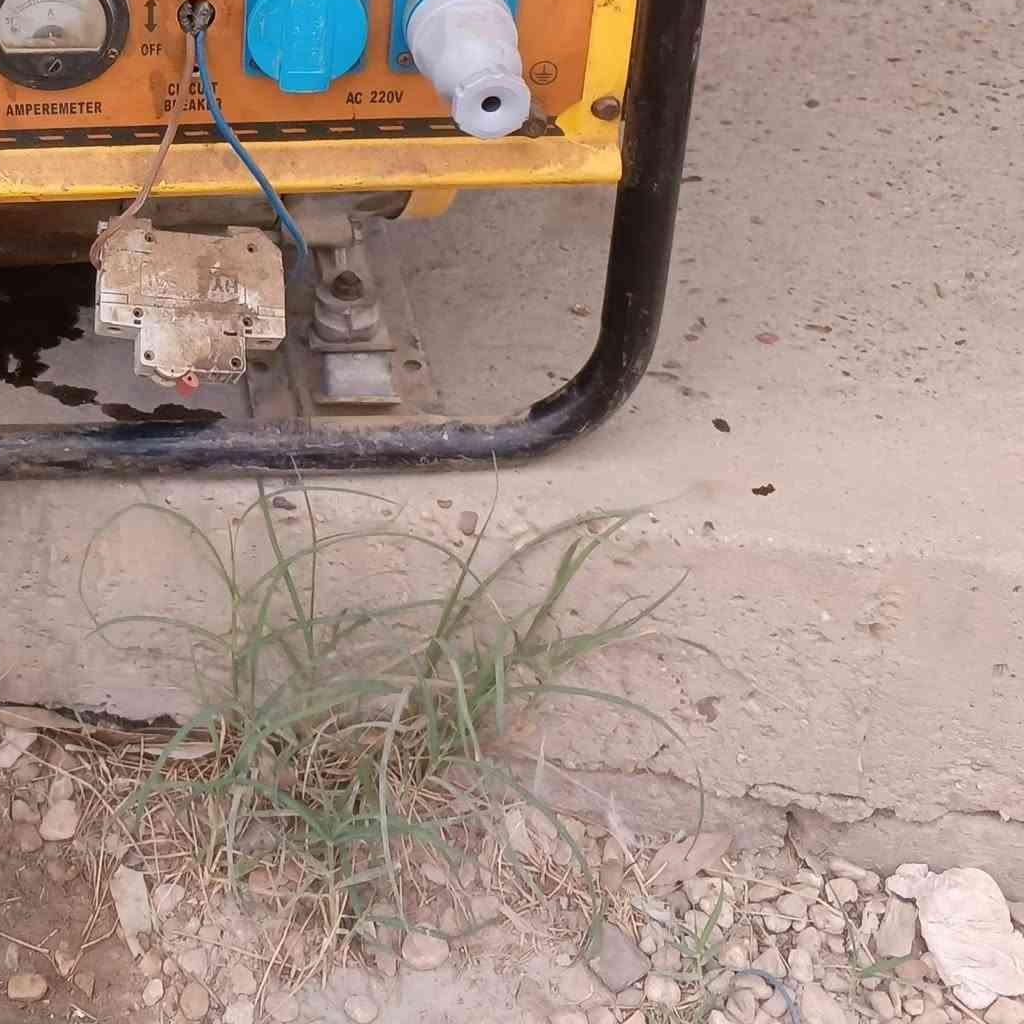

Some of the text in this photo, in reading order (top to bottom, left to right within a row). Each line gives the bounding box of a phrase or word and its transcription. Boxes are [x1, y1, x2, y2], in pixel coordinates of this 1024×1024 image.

[140, 42, 163, 56] OFF
[345, 89, 404, 105] AC 220V
[5, 101, 102, 117] AMPEREMETER
